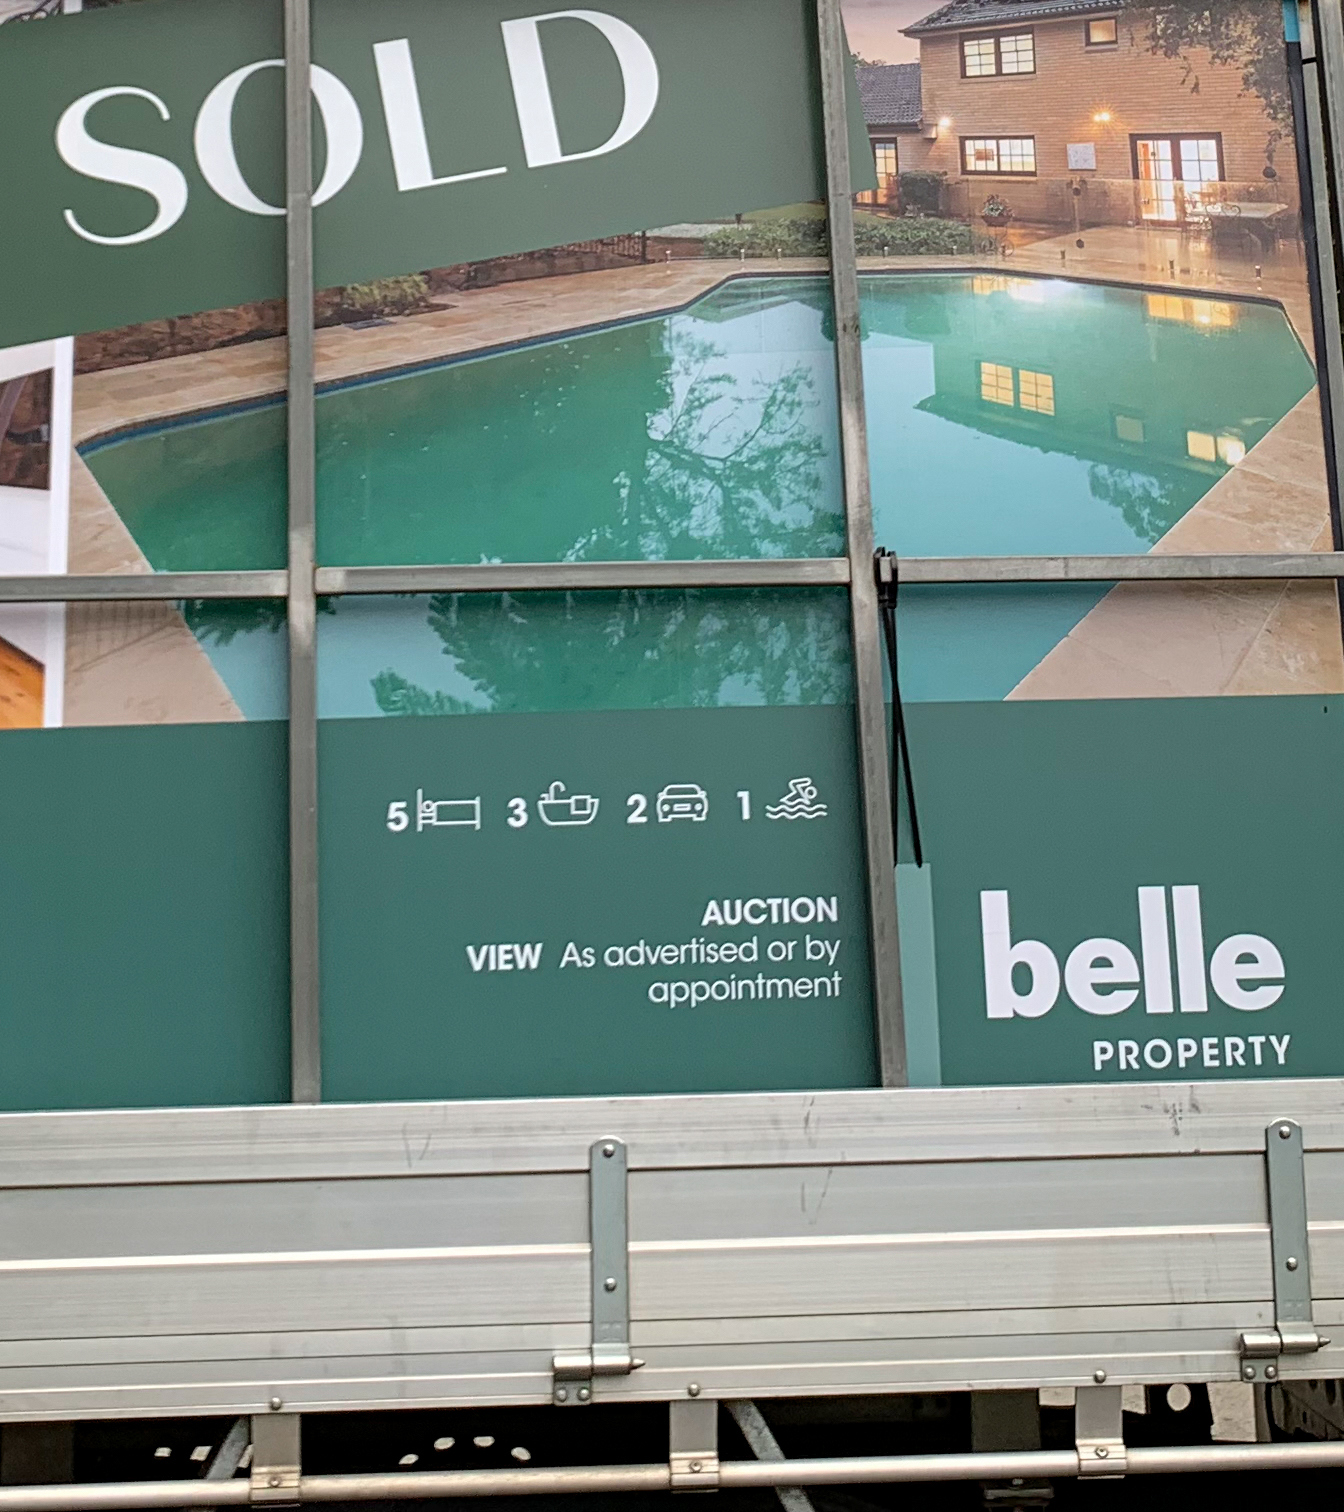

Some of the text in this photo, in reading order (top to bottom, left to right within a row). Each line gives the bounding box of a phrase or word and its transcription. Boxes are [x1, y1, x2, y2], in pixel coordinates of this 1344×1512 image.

[54, 8, 659, 246] SOLD
[386, 790, 751, 832] 5 3 2 1
[700, 896, 838, 927] AUCTION
[465, 934, 842, 972] VIEW As advertised or by
[979, 884, 1286, 1019] belle
[647, 973, 843, 1009] appointment
[1093, 1034, 1291, 1071] PROPERTY
